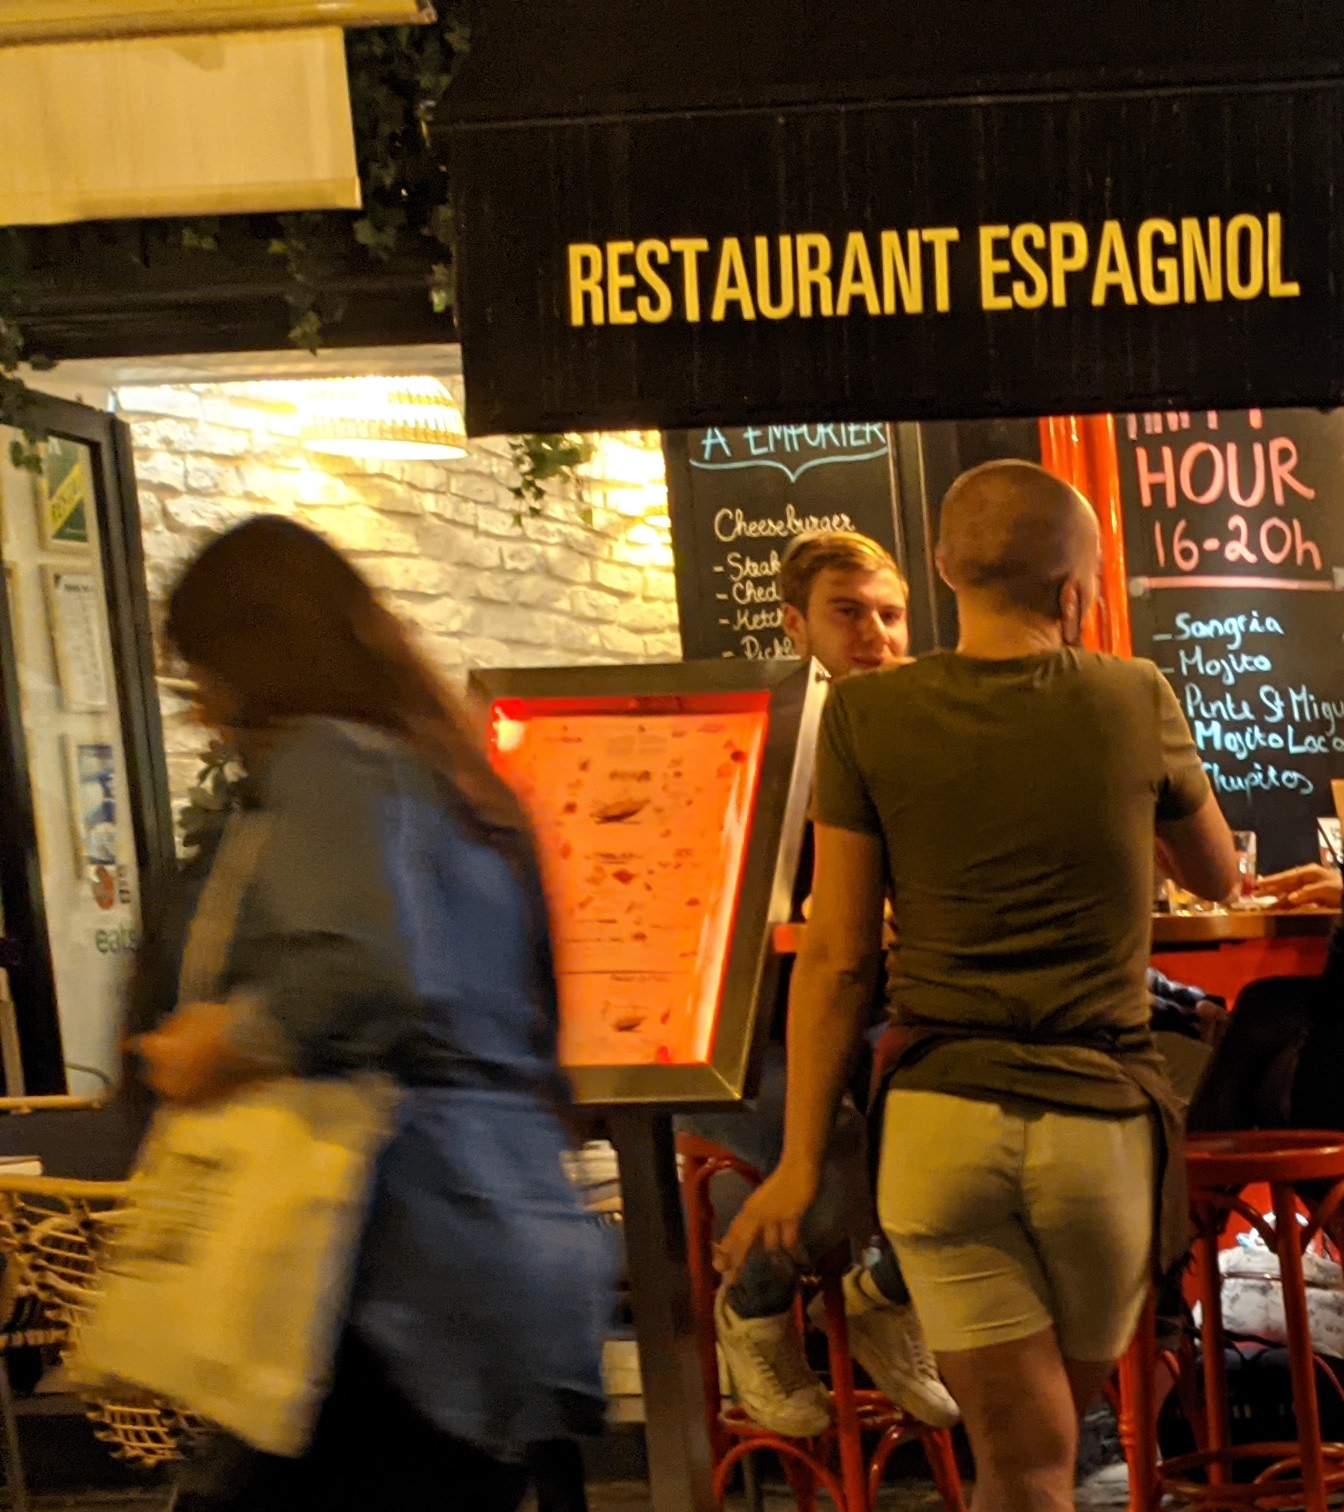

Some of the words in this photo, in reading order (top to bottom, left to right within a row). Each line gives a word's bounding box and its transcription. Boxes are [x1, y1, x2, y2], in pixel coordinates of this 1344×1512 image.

[567, 227, 960, 326] RESTAURANT
[978, 212, 1300, 311] ESPAGNOL
[743, 422, 887, 456] EMPORTER
[1135, 436, 1316, 509] HOUR
[713, 503, 856, 543] Cheeseburger
[1154, 513, 1322, 572] 16-20h
[1175, 611, 1286, 650] Sangria
[1178, 645, 1272, 686] Mojito
[1184, 682, 1256, 722] Pinte
[1193, 719, 1285, 761] Mojito
